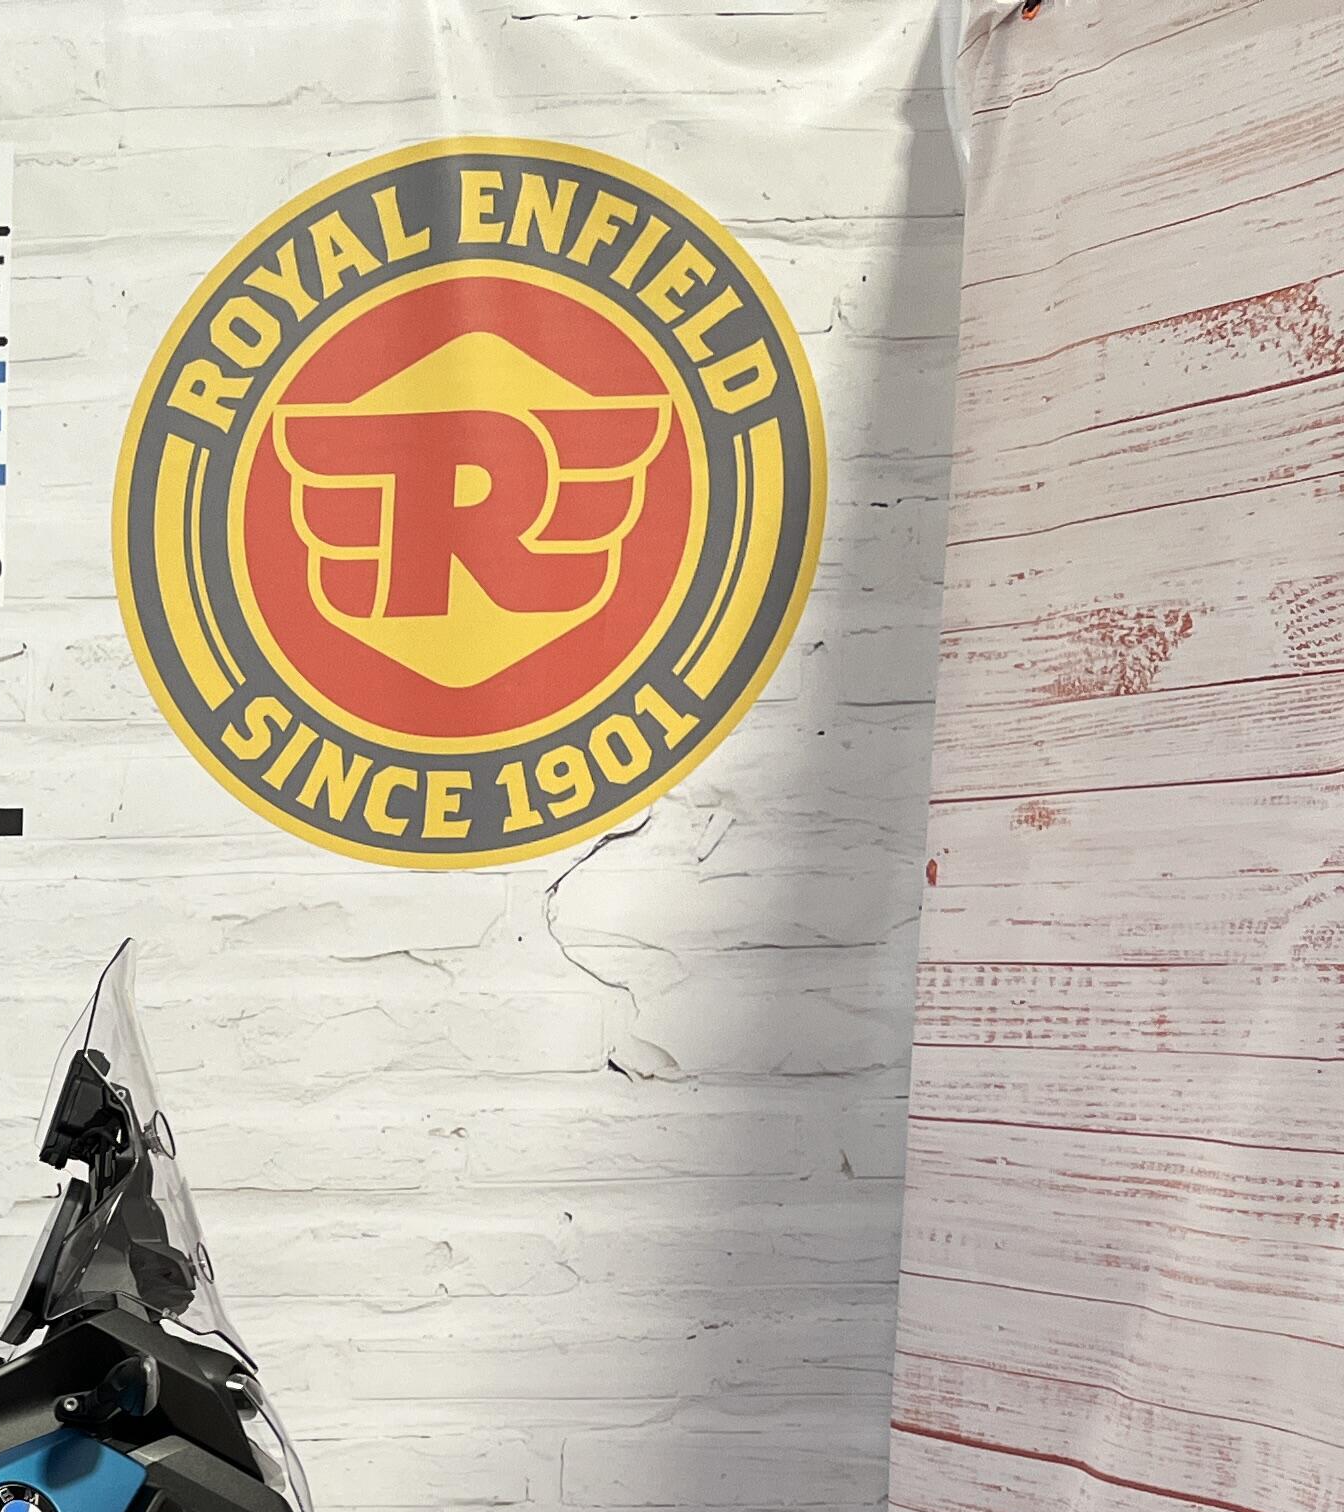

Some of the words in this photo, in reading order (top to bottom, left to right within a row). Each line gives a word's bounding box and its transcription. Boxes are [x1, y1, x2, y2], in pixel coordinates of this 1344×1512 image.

[167, 187, 432, 433] ROYAL
[458, 169, 777, 416] ENFIELD
[221, 696, 473, 839] SINCE
[497, 684, 701, 833] 1901
